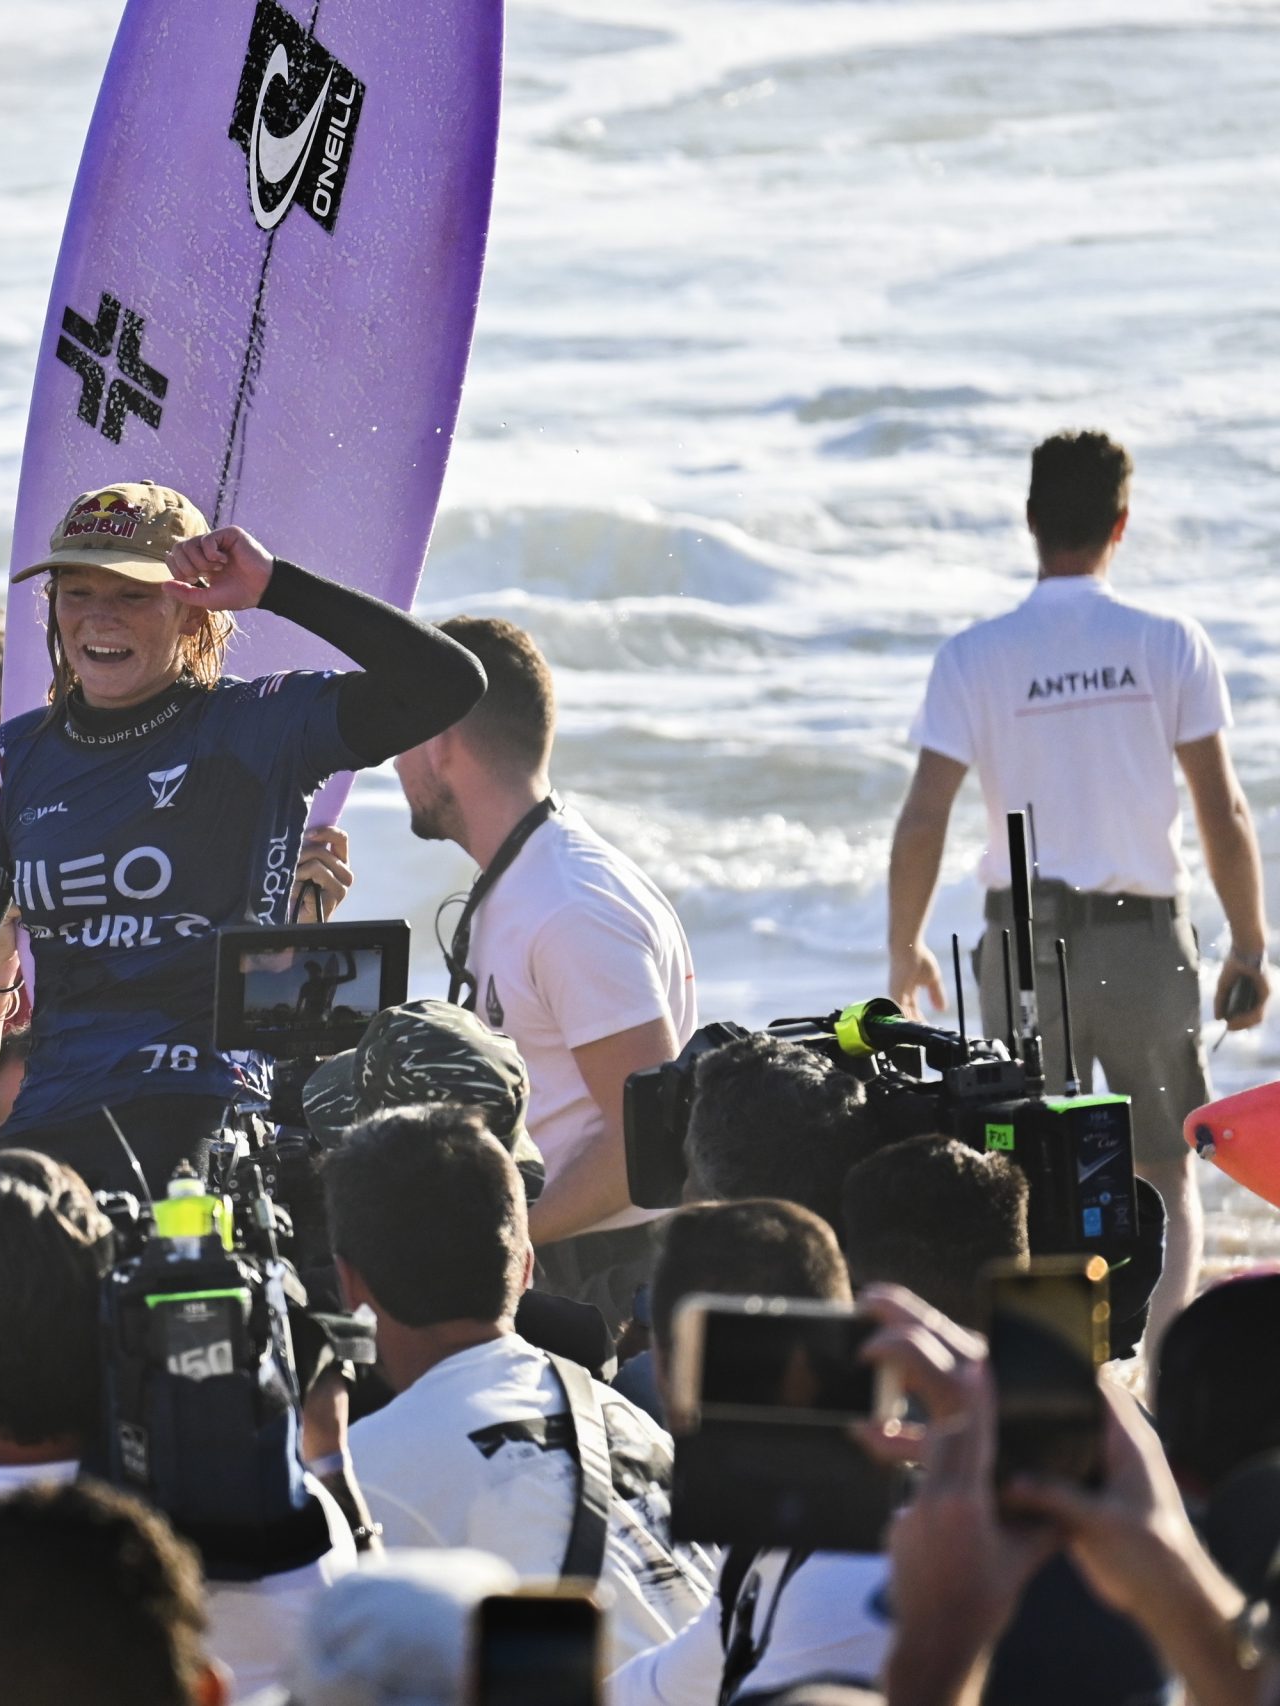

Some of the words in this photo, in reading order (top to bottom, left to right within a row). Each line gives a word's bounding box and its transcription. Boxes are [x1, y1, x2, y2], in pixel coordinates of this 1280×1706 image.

[312, 83, 357, 218] O'NEILL
[64, 518, 97, 538] Red
[96, 517, 137, 539] Bull
[1027, 666, 1136, 701] ANTHEA
[98, 729, 132, 745] SURF
[134, 702, 181, 737] LEAGUE
